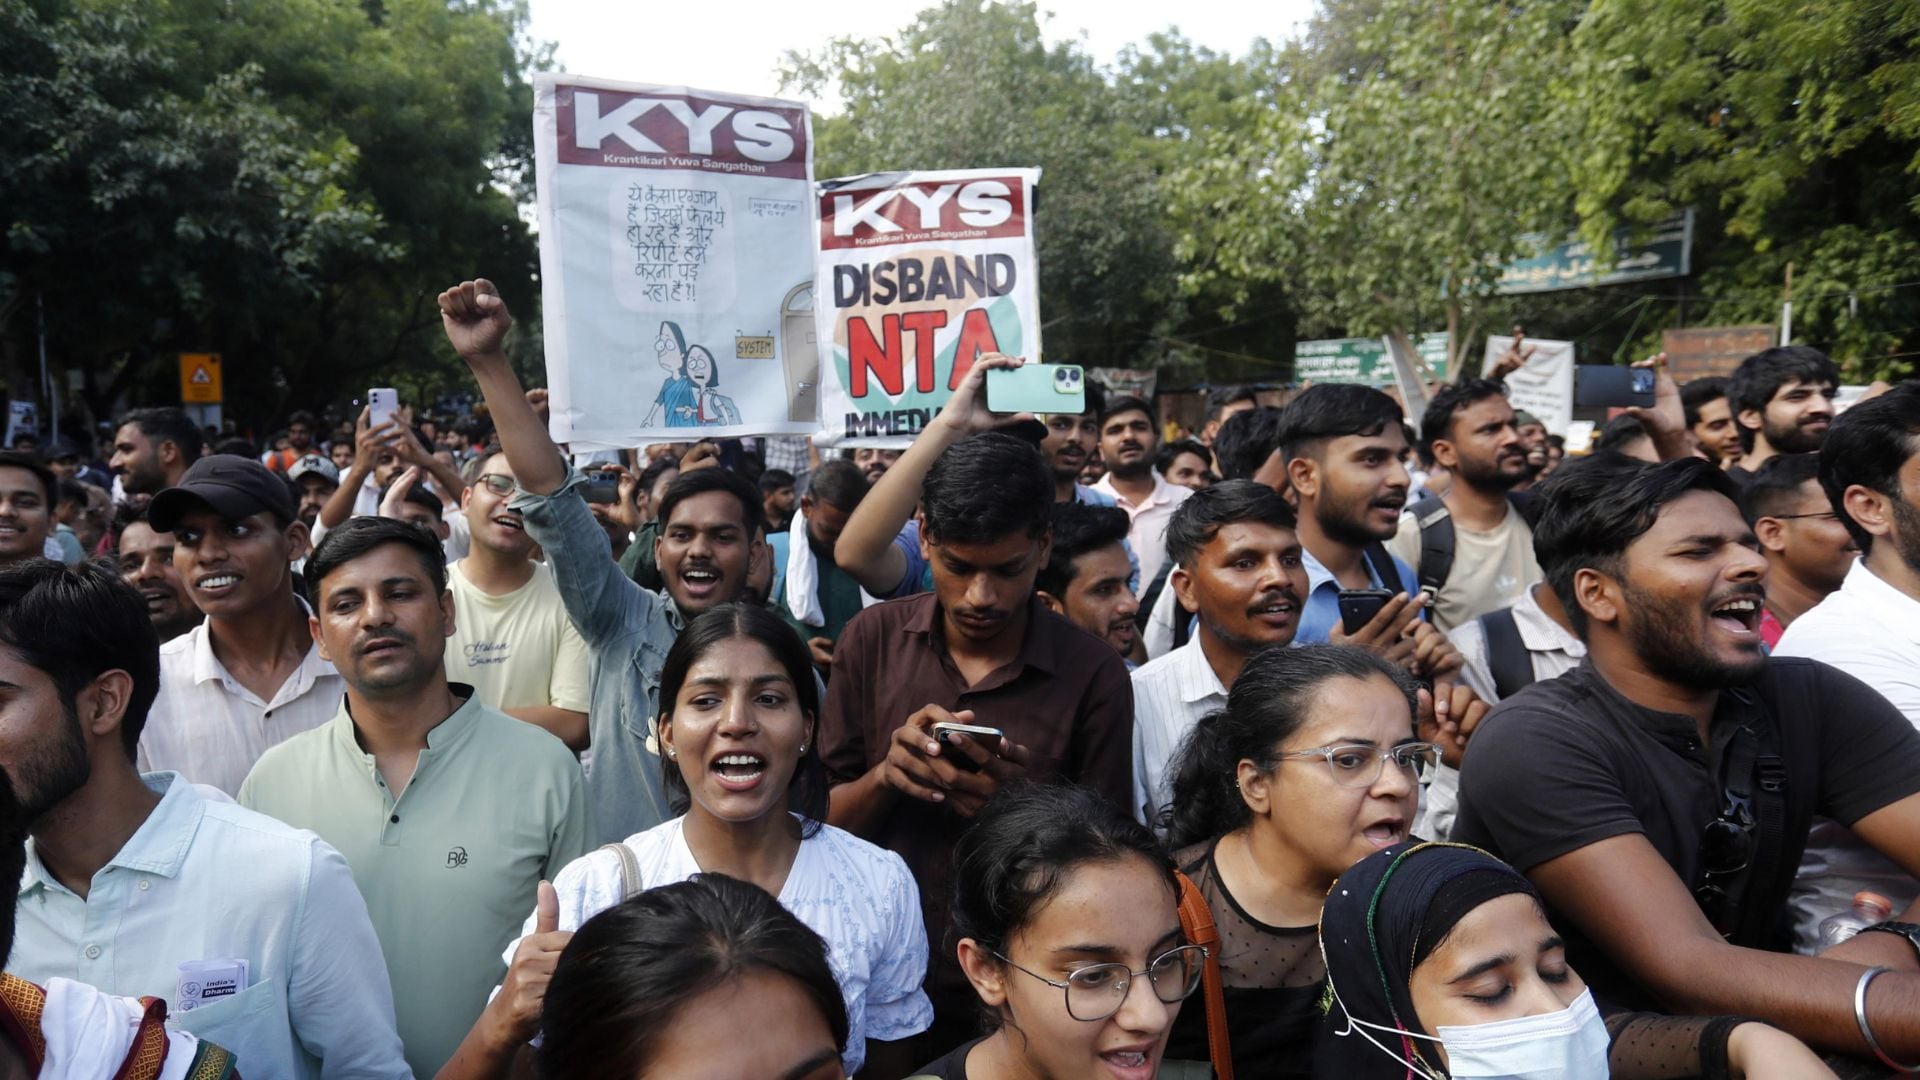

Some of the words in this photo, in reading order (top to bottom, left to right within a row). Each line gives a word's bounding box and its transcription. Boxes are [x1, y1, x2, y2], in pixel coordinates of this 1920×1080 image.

[574, 91, 794, 162] KYS
[604, 154, 667, 166] Krantikari
[669, 156, 700, 167] Yuva
[702, 158, 765, 173] Sangathan
[834, 181, 1012, 236] KYS
[855, 234, 904, 245] Krantikari
[905, 232, 930, 241] Yuva
[931, 229, 988, 239] Sangathan
[833, 253, 1016, 308] DISBAND
[736, 341, 772, 355] SYSTEM
[847, 308, 1001, 398] NTA
[206, 979, 235, 987] India's
